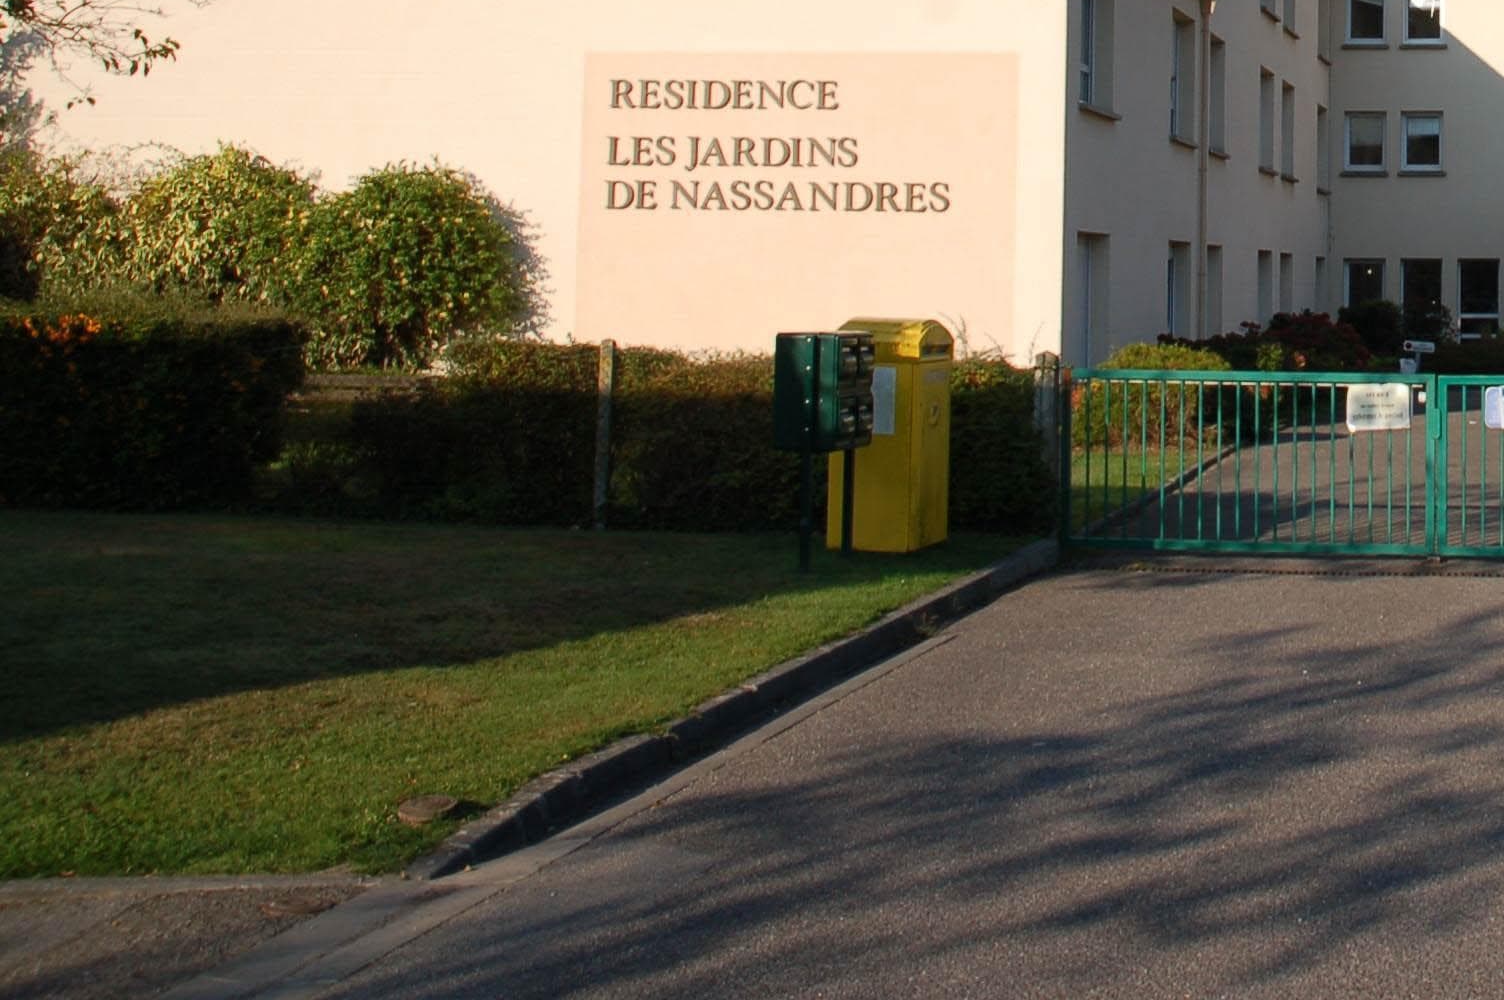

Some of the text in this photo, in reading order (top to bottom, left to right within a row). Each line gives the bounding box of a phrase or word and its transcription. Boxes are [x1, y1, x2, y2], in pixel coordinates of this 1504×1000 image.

[609, 78, 840, 111] RESIDENCE
[605, 136, 859, 172] LES JARDINS
[604, 179, 952, 214] DE NASSANDRES
